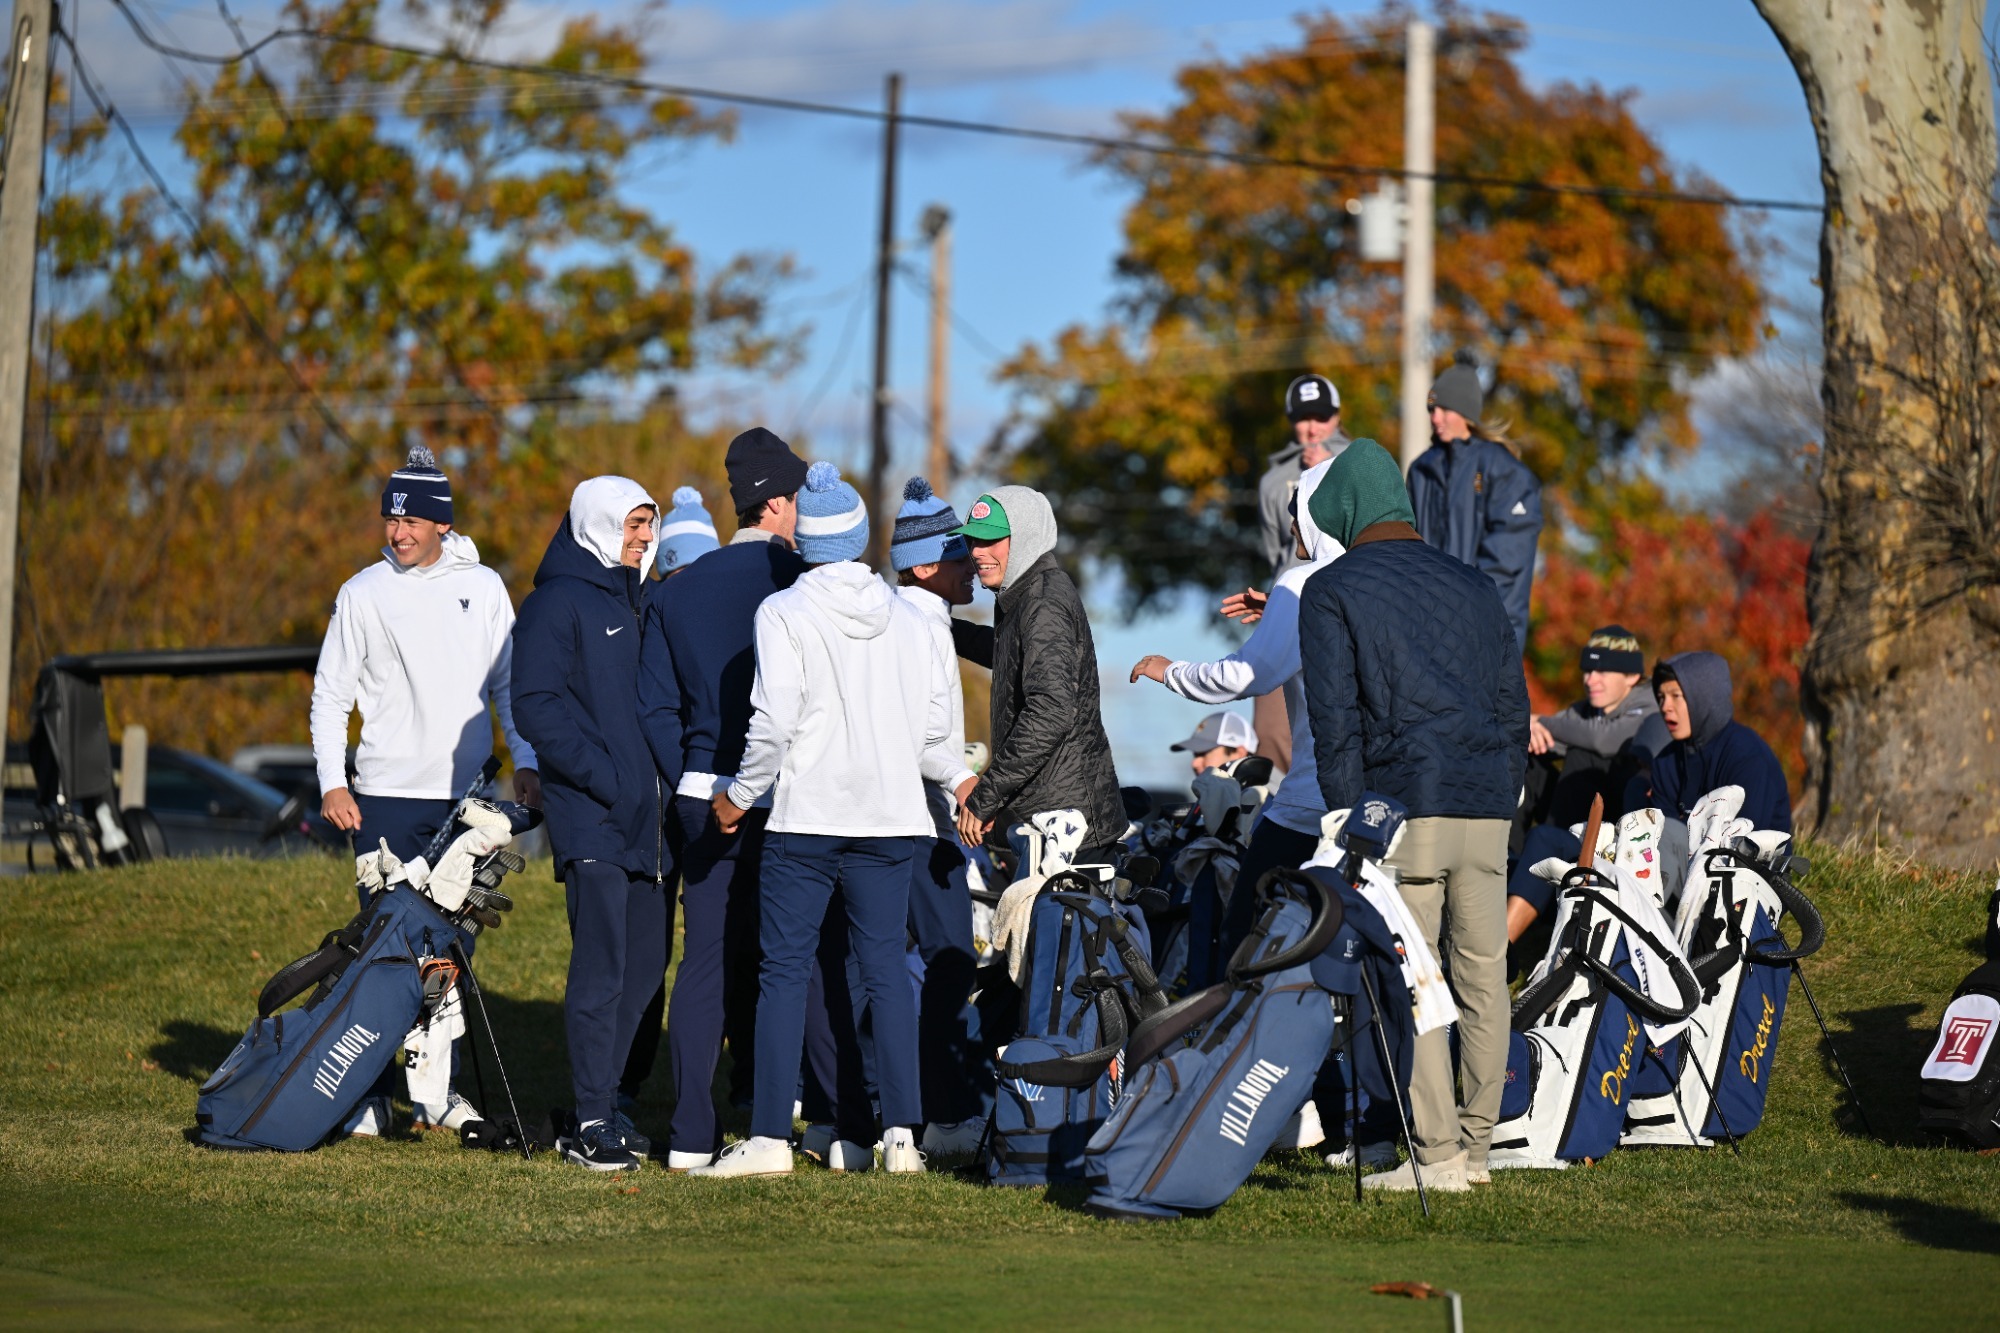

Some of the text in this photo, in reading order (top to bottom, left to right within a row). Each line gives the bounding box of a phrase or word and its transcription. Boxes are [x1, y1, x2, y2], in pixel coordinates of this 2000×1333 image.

[1299, 381, 1320, 402] S
[390, 507, 406, 516] GOLF
[392, 492, 408, 509] V
[312, 1023, 379, 1101] VILLANOVA
[1601, 1012, 1640, 1106] Drexel
[1740, 992, 1775, 1084] Drexel
[1943, 1019, 1990, 1061] T
[1219, 1058, 1286, 1148] VILLANOVA
